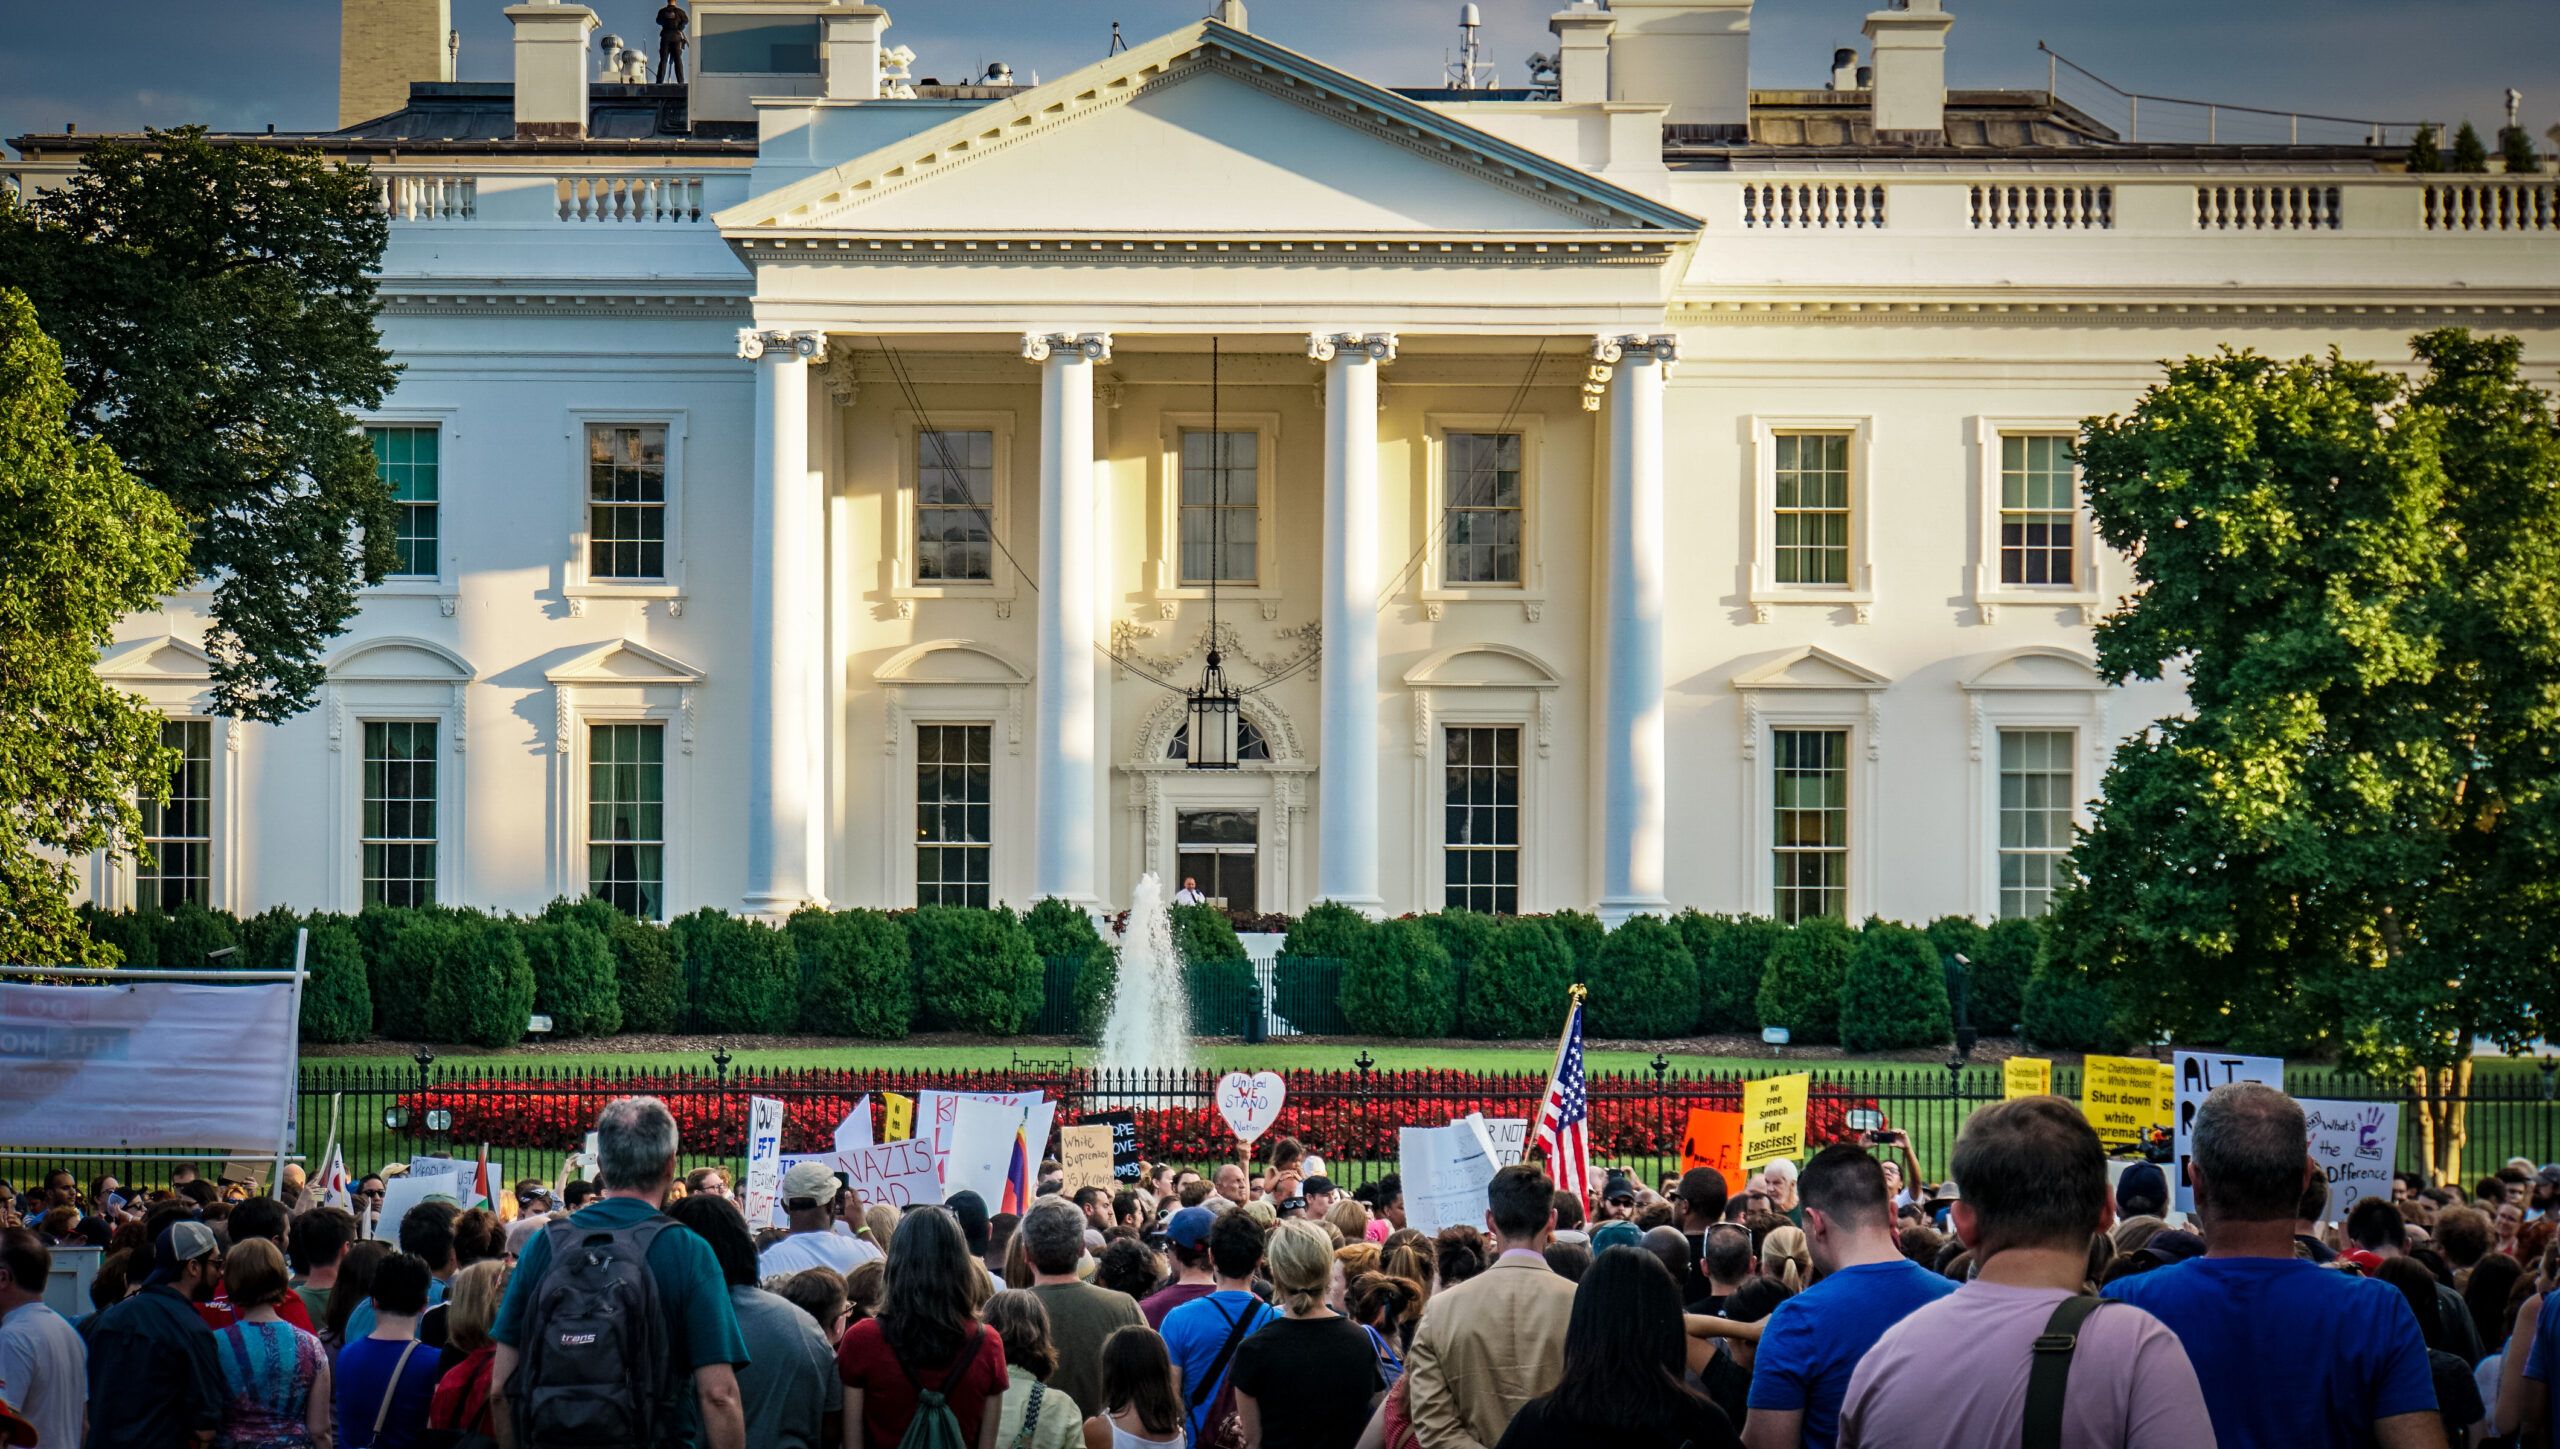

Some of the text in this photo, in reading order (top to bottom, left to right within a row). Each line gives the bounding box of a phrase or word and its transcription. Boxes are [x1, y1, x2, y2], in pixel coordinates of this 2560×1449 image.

[2107, 1063, 2157, 1077] Charlottesville
[1232, 1076, 1267, 1088] United
[2108, 1075, 2127, 1087] White
[1238, 1088, 1258, 1099] WE
[2091, 1090, 2151, 1107] Shut down
[1225, 1094, 1268, 1109] STAND
[1766, 1096, 1782, 1106] Free
[1760, 1107, 1788, 1119] Speech
[2104, 1112, 2136, 1124] white
[1112, 1122, 1135, 1137] OPE
[1234, 1120, 1260, 1132] Nation
[1501, 1124, 1528, 1142] NOT
[1764, 1122, 1782, 1134] For
[2093, 1127, 2144, 1139] upremac
[1113, 1140, 1137, 1155] OVE
[1748, 1133, 1797, 1153] Fascists!
[2319, 1141, 2341, 1157] the
[839, 1141, 932, 1183] NAZIS
[2327, 1162, 2388, 1183] Difference
